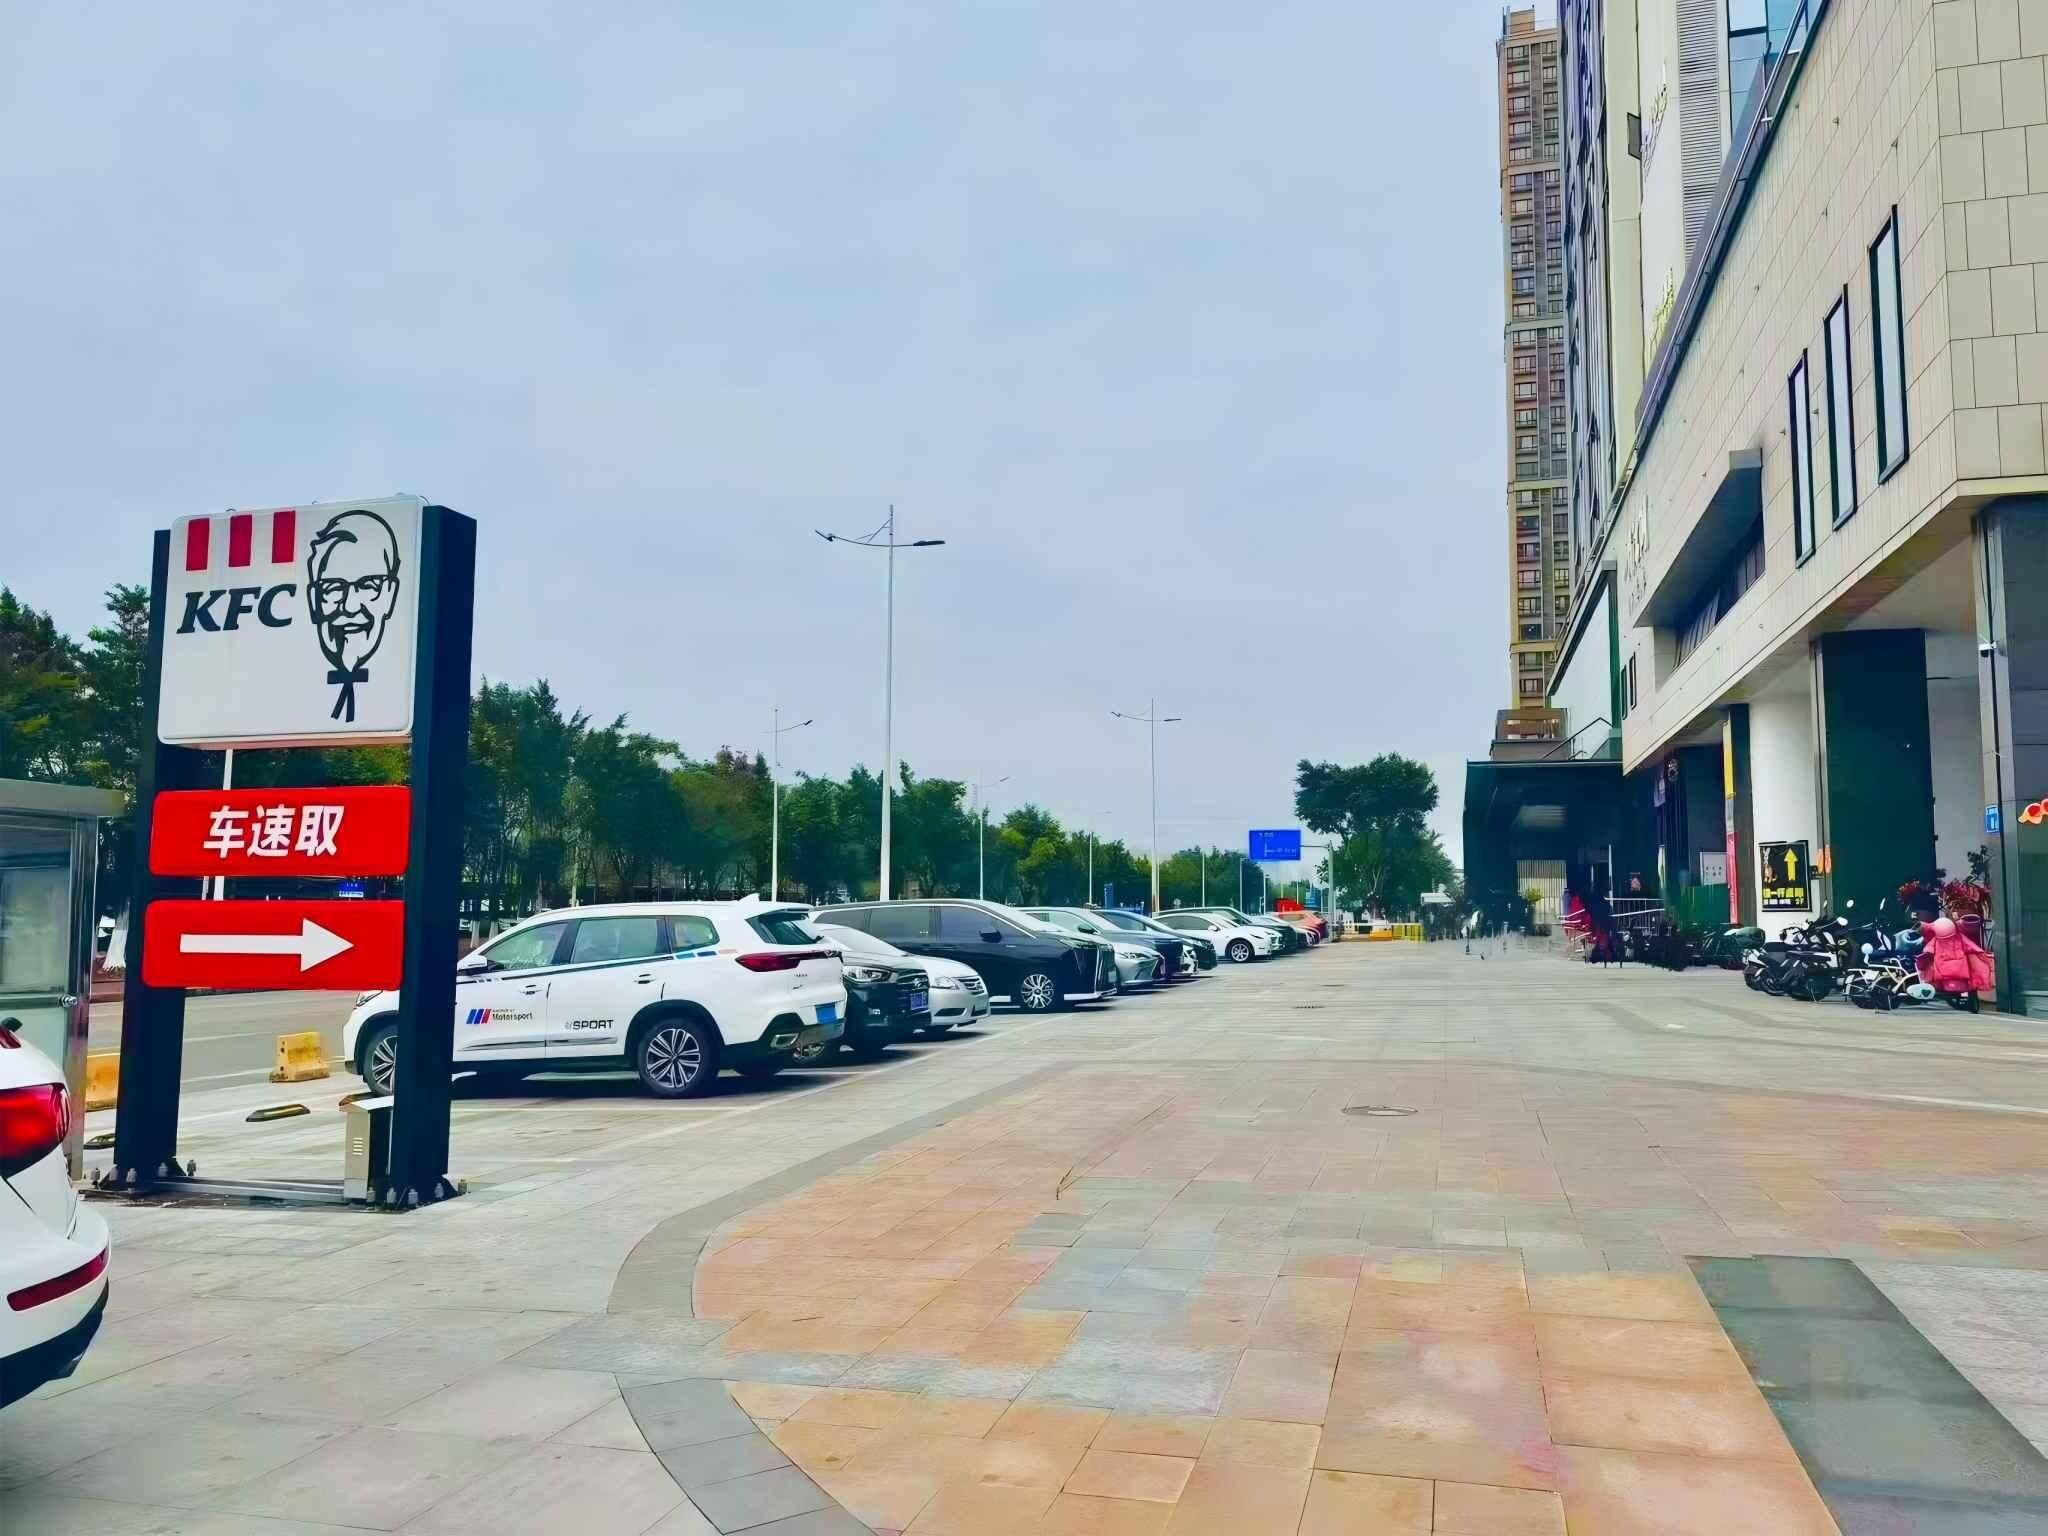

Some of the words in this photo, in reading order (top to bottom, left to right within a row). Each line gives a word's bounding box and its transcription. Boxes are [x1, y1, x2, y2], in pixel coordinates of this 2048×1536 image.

[176, 584, 297, 634] KFC
[203, 804, 345, 859] 车速取
[492, 1012, 533, 1021] Motorsport
